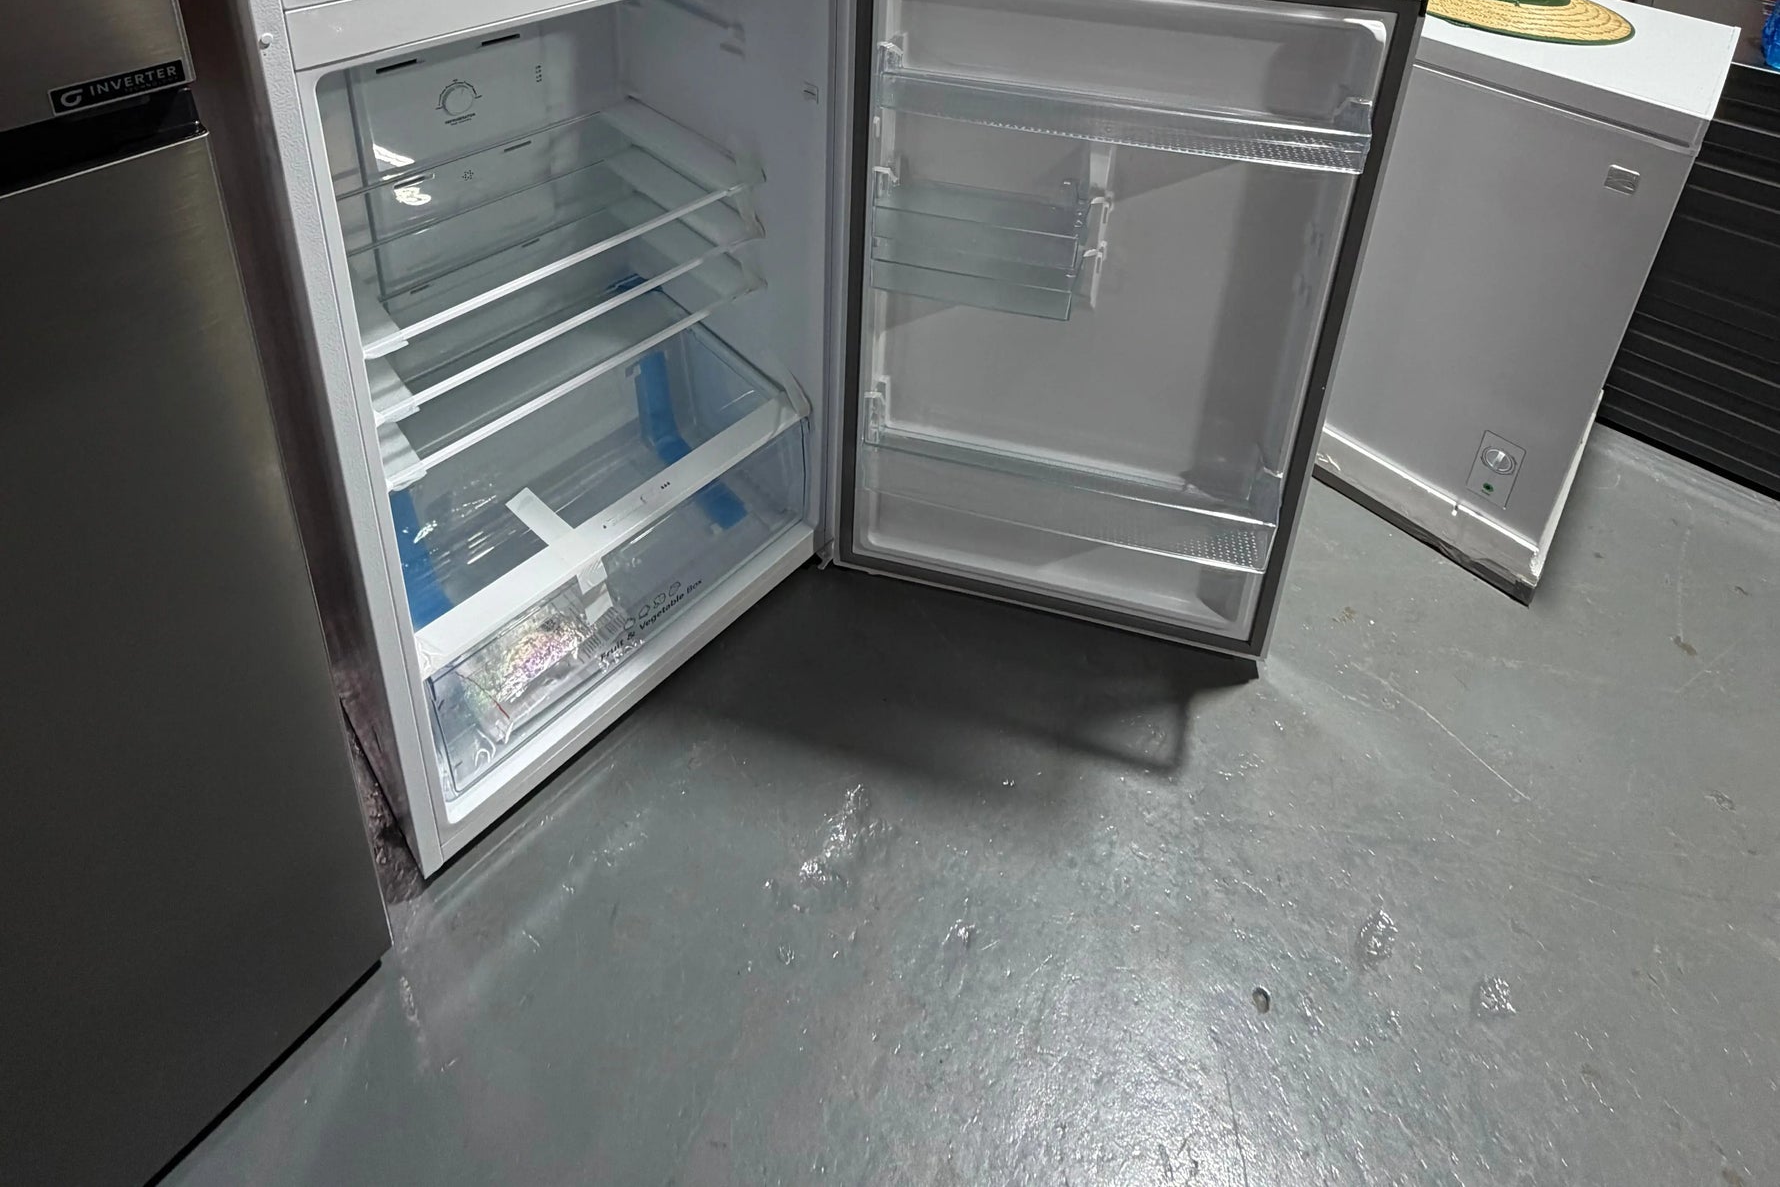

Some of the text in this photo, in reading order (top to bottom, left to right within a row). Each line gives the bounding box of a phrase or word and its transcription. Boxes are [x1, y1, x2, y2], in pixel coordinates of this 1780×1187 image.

[89, 65, 177, 97] INVERTER
[600, 639, 625, 661] Fruit
[639, 592, 684, 630] Vegetable
